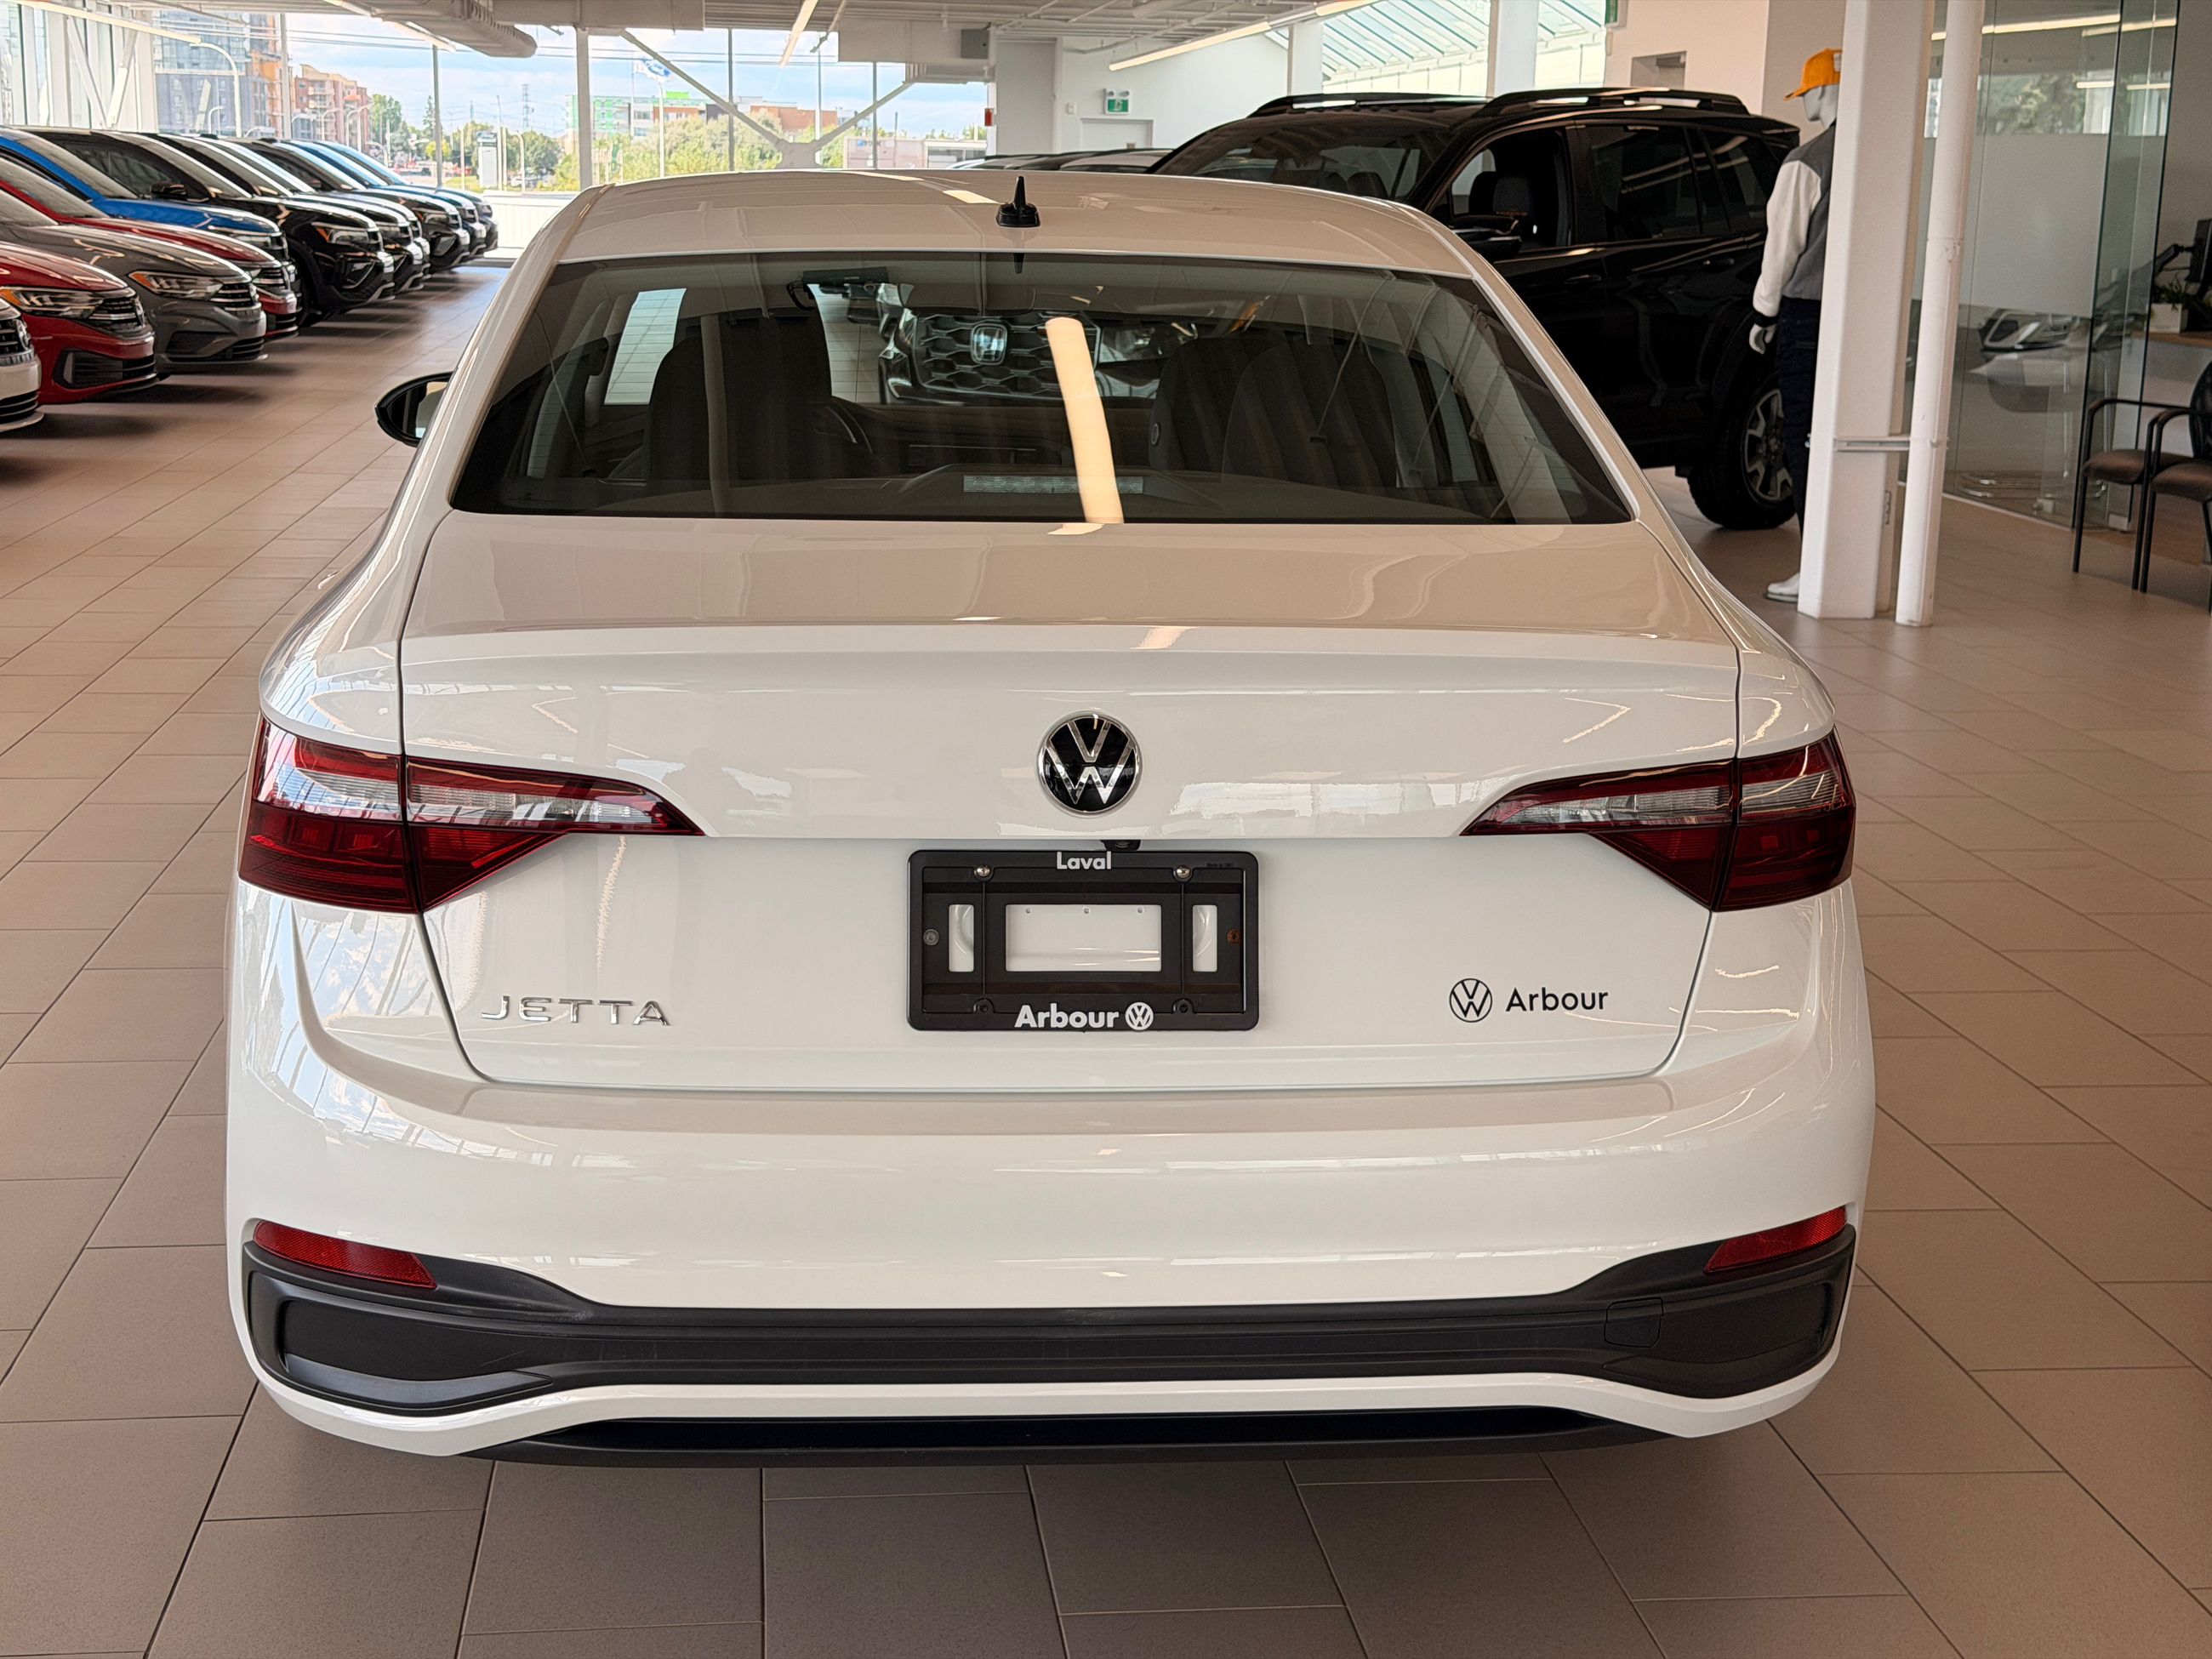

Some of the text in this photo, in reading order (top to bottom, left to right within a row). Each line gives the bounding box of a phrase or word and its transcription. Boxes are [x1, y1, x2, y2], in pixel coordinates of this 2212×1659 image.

[1038, 711, 1142, 817] VW
[1057, 851, 1112, 869] Laval
[481, 995, 670, 1026] JETTA
[1014, 1002, 1120, 1029] Arbour
[1449, 978, 1609, 1023] VW Arbour
